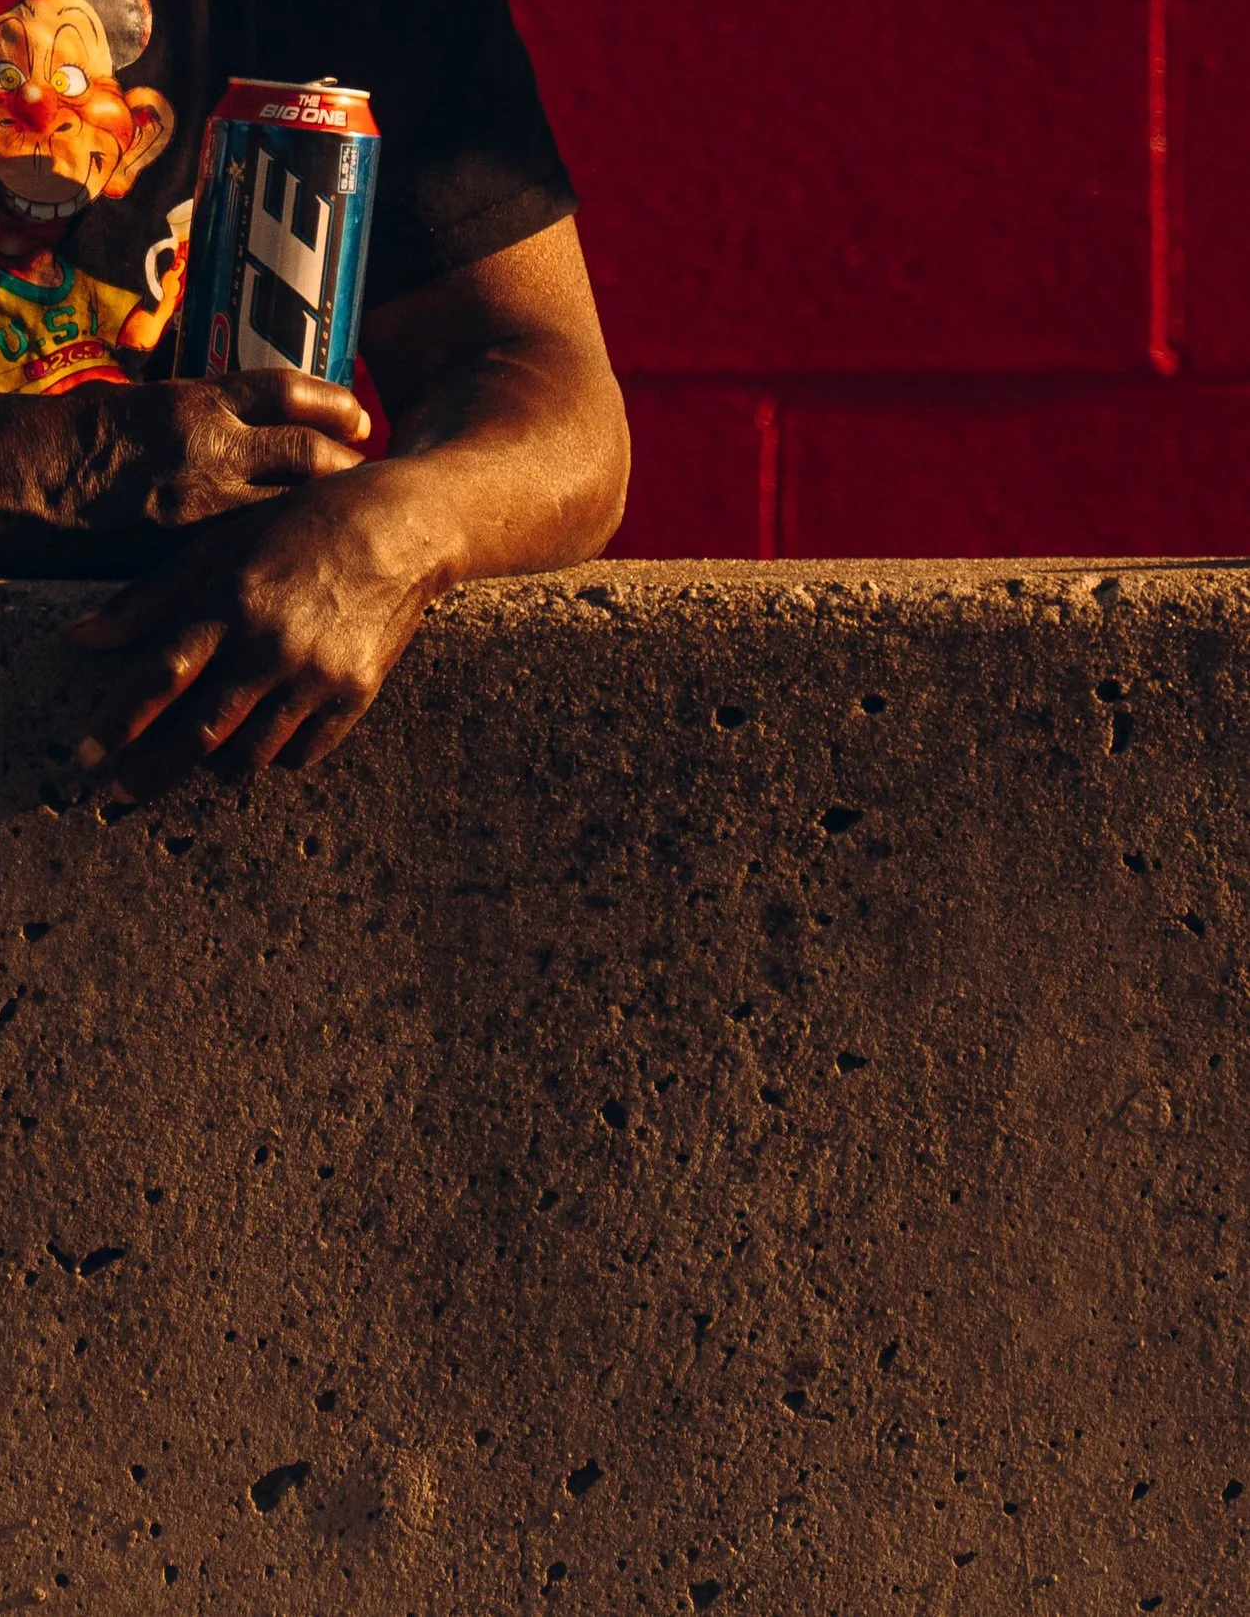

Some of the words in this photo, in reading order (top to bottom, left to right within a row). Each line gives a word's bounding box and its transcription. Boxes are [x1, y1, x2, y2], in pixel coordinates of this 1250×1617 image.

[297, 94, 321, 108] THE
[258, 104, 300, 121] BIG
[301, 108, 347, 127] ONE
[319, 299, 332, 370] LAGER
